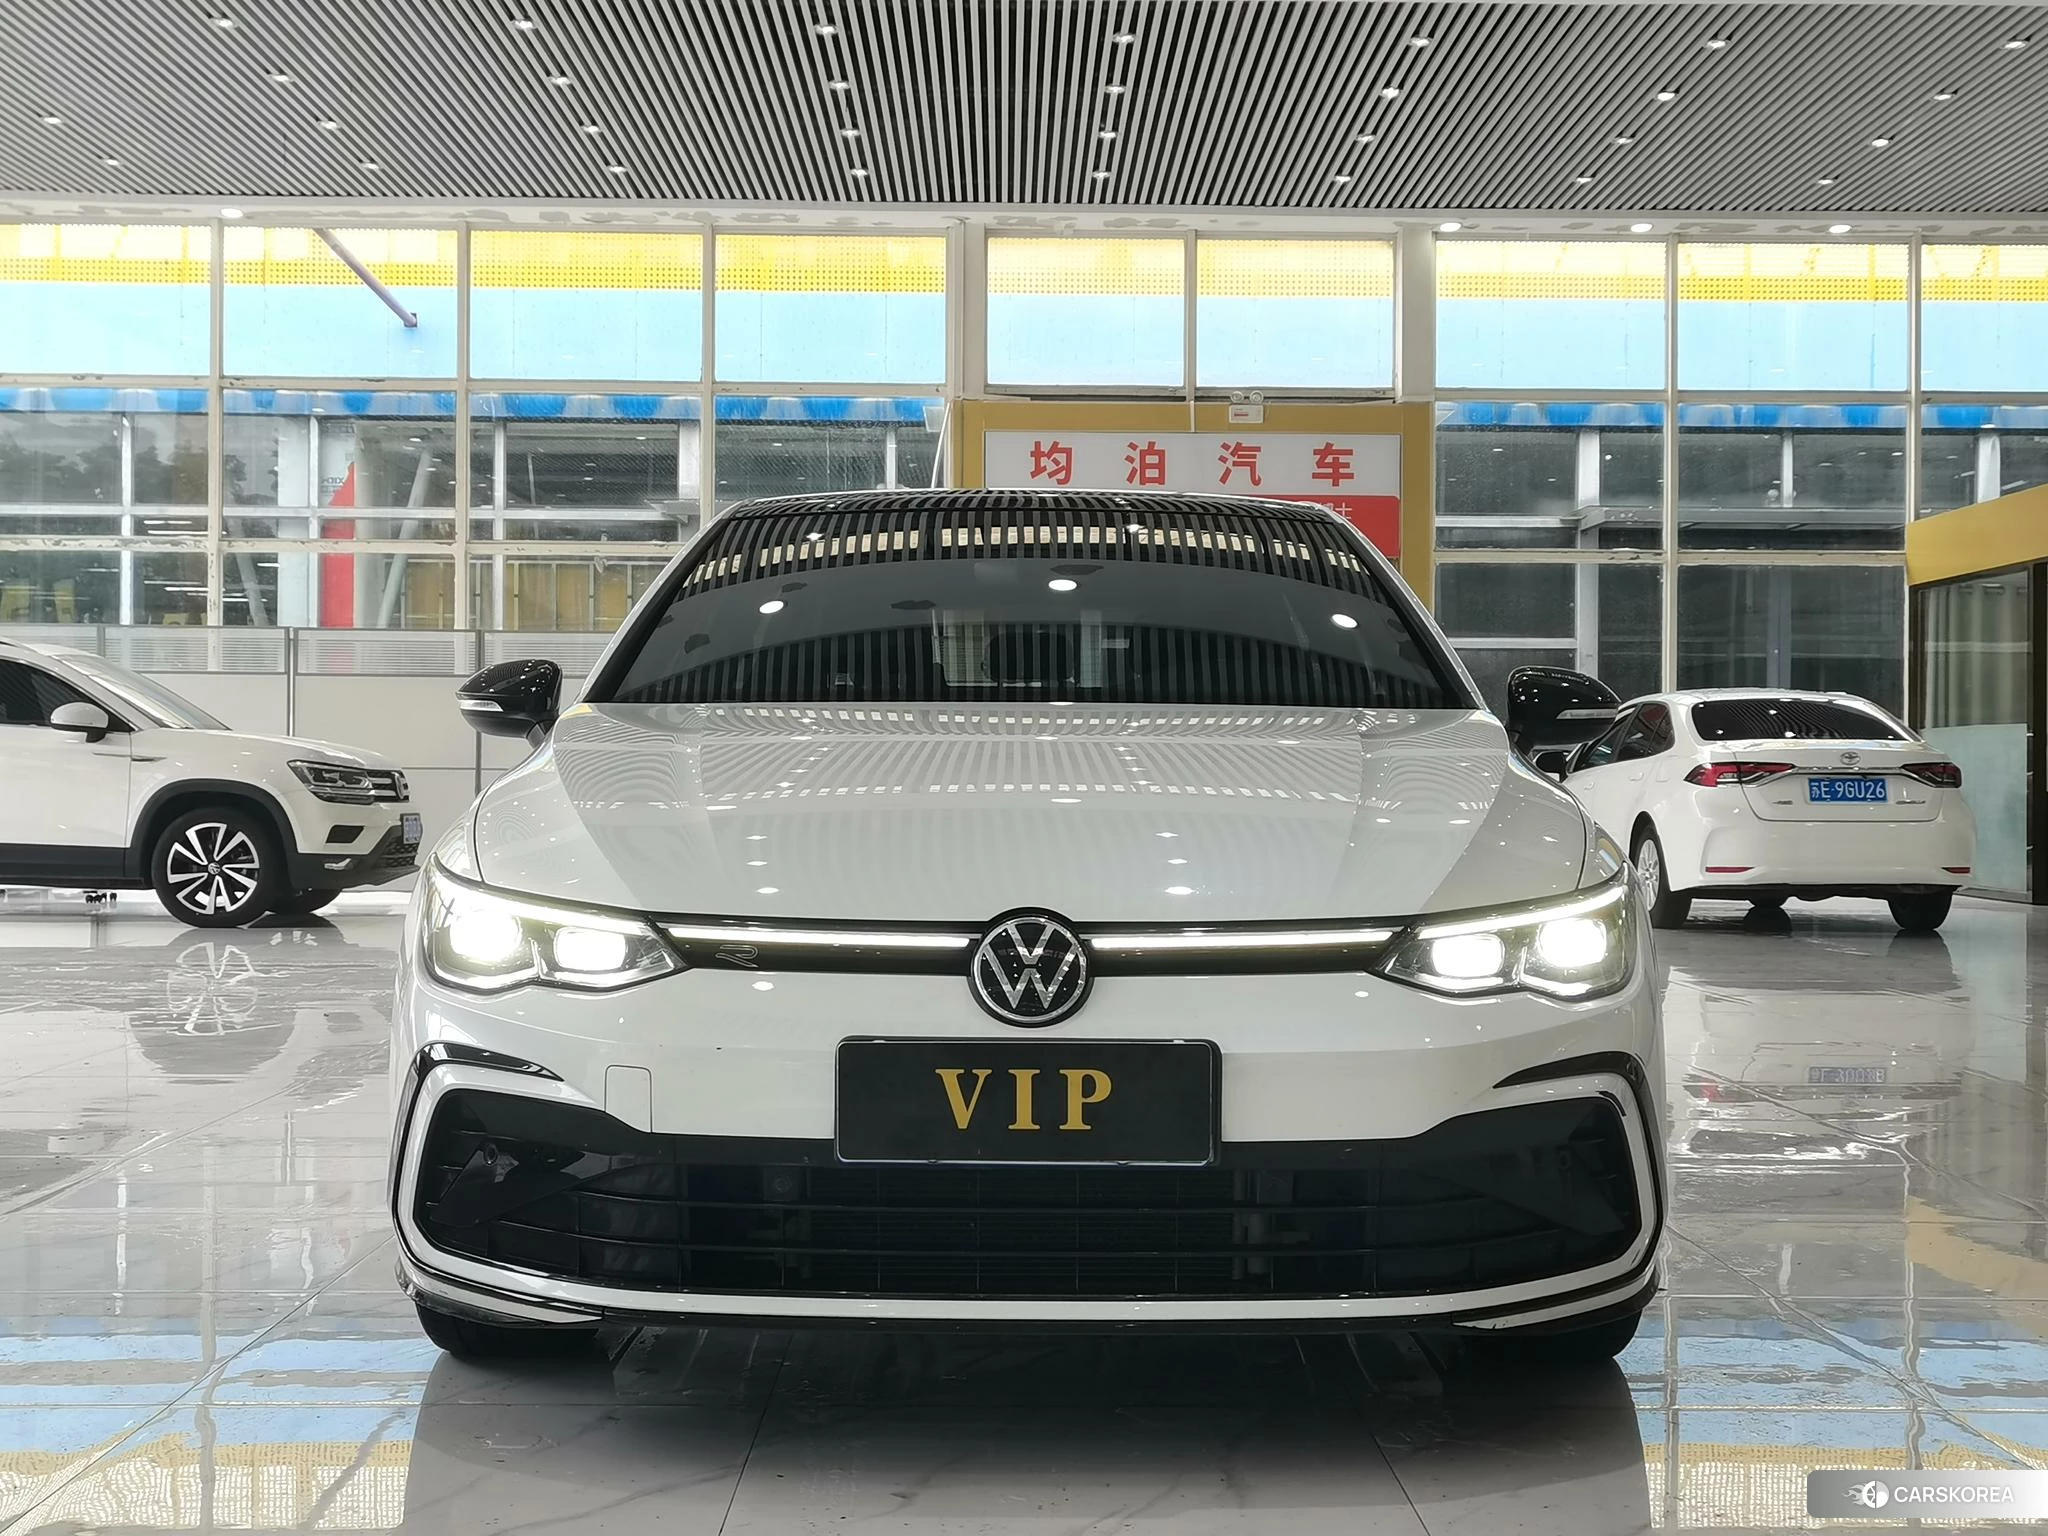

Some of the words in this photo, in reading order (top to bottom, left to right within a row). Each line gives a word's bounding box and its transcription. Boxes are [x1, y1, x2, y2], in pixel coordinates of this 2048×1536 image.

[1029, 440, 1355, 488] 均泊汽车
[934, 1068, 1113, 1130] VIP
